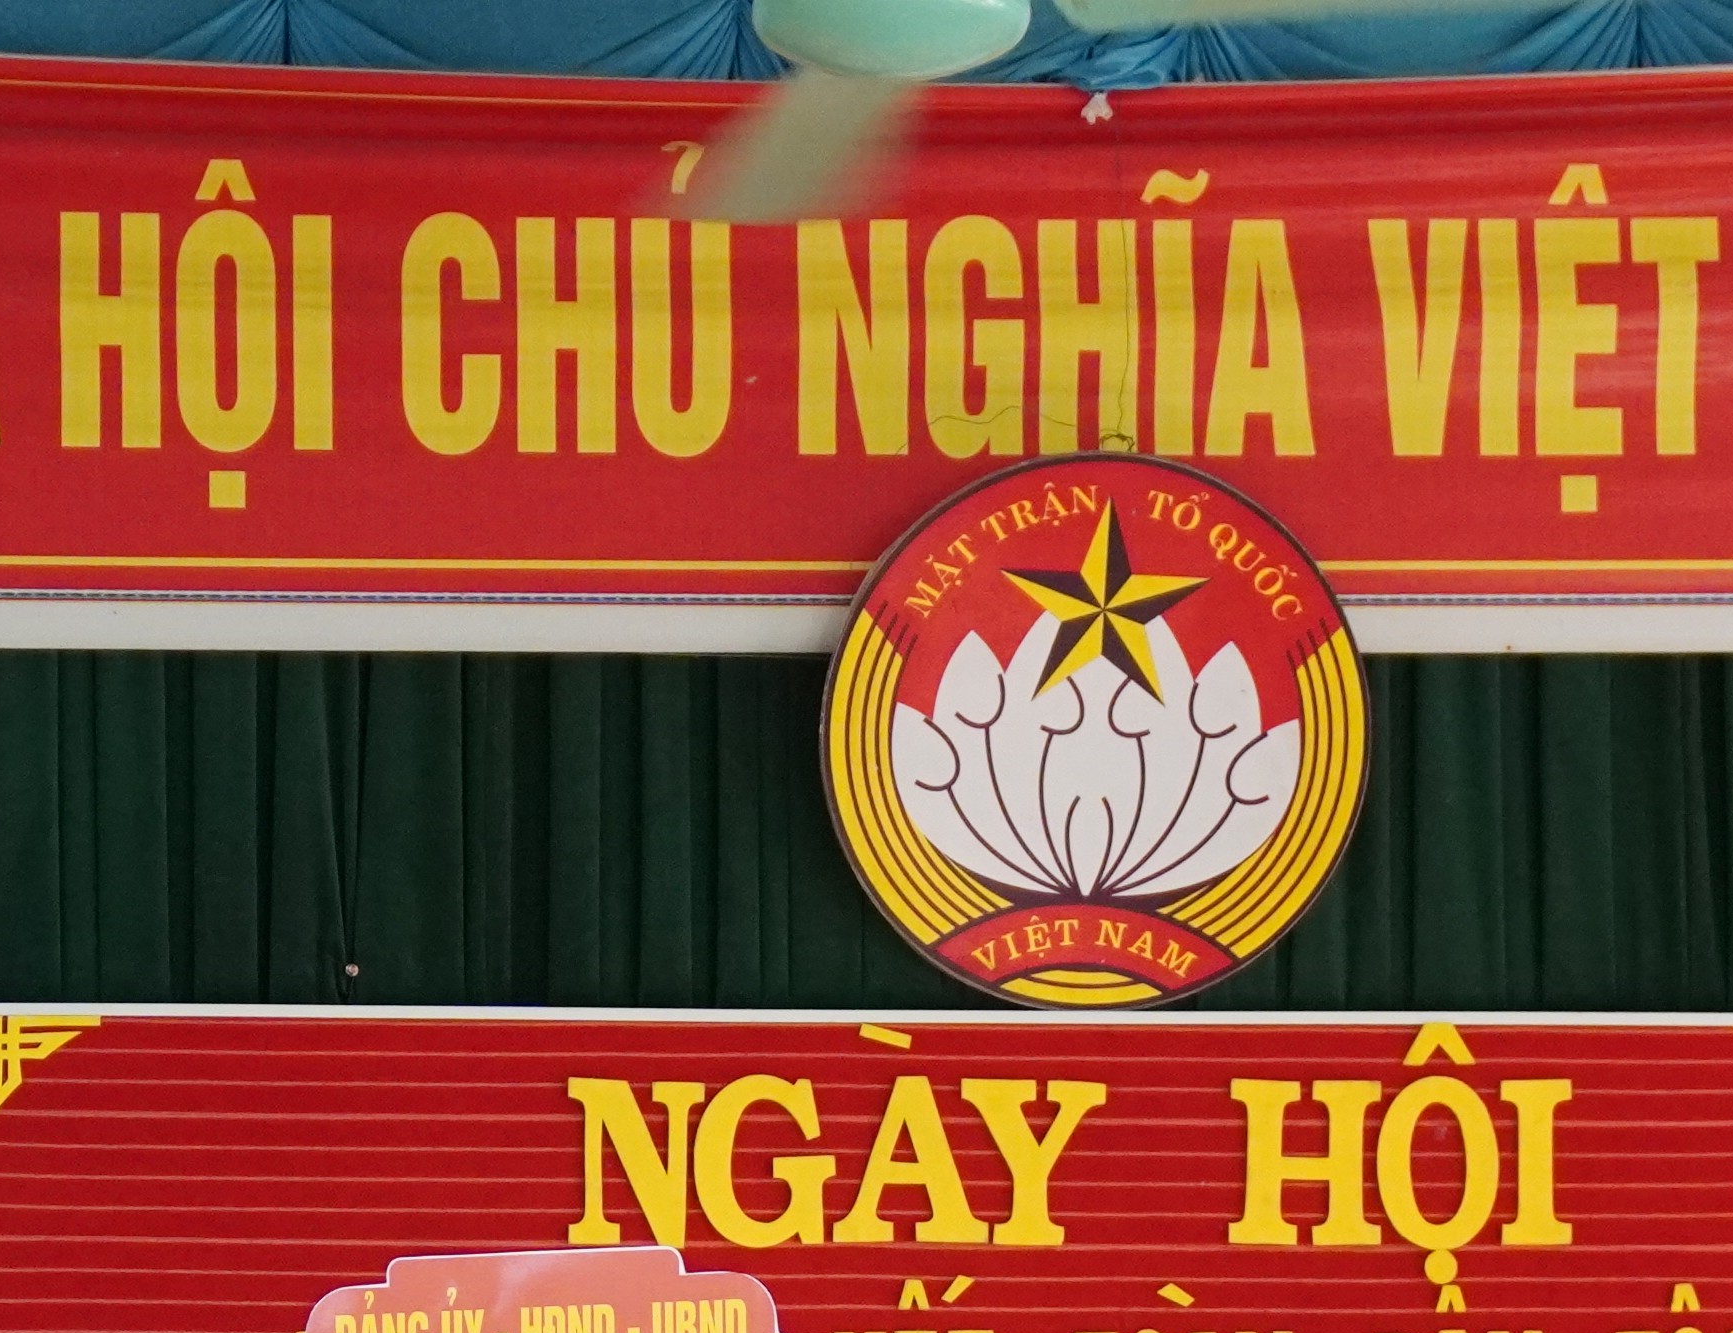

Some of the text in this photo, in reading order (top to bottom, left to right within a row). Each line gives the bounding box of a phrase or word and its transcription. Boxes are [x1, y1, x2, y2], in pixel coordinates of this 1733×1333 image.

[60, 159, 334, 508] HỘI
[401, 140, 732, 457] CHỦ
[797, 169, 1315, 458] NGHĨA
[1369, 164, 1720, 512] VIỆT
[904, 481, 1303, 621] MẶT TRẬN TỔ QUỐC
[971, 915, 1197, 978] VIỆT NAM
[568, 1022, 1573, 1284] NGÀY HỘI
